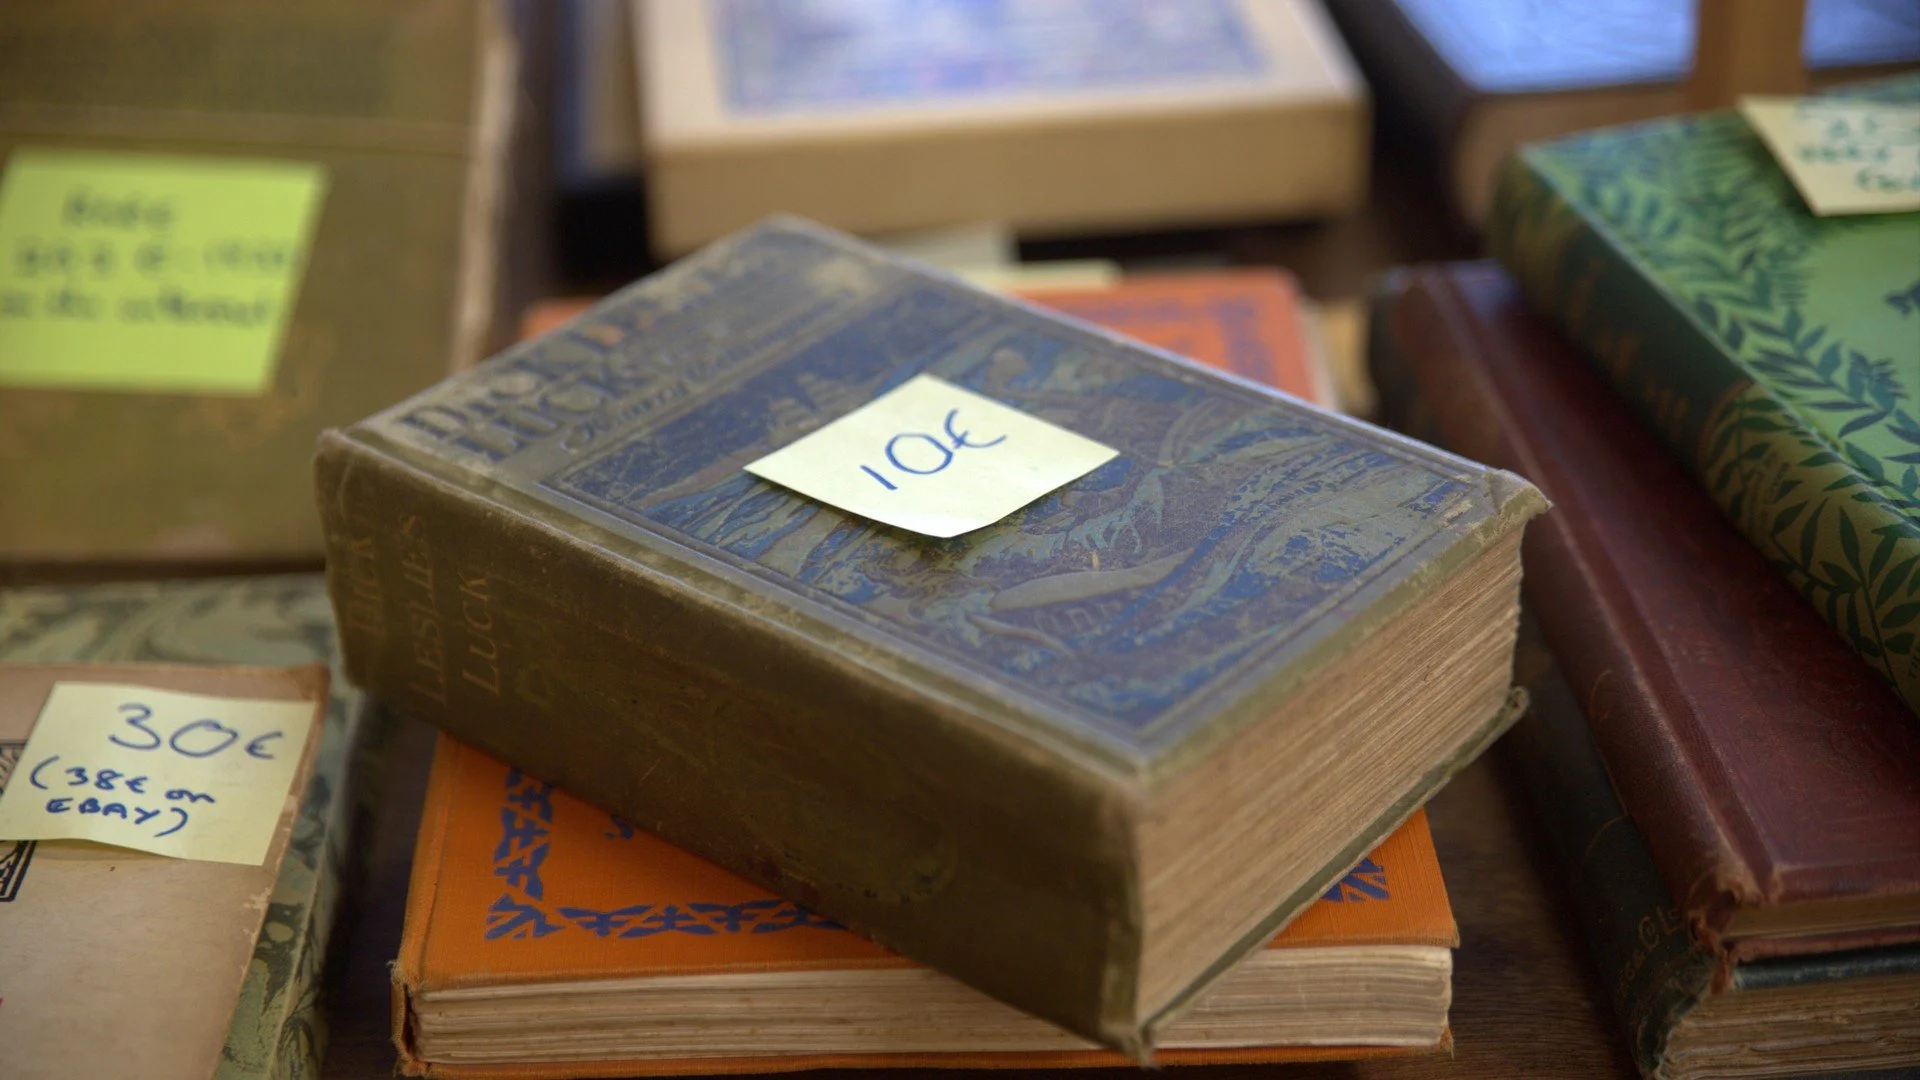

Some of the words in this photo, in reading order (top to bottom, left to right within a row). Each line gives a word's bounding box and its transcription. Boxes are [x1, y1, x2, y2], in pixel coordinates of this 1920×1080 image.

[859, 408, 1008, 491] 10€
[457, 562, 502, 697] LUCK
[108, 702, 284, 759] 30€
[29, 755, 149, 794] (38€
[45, 797, 189, 838] EBAY)
